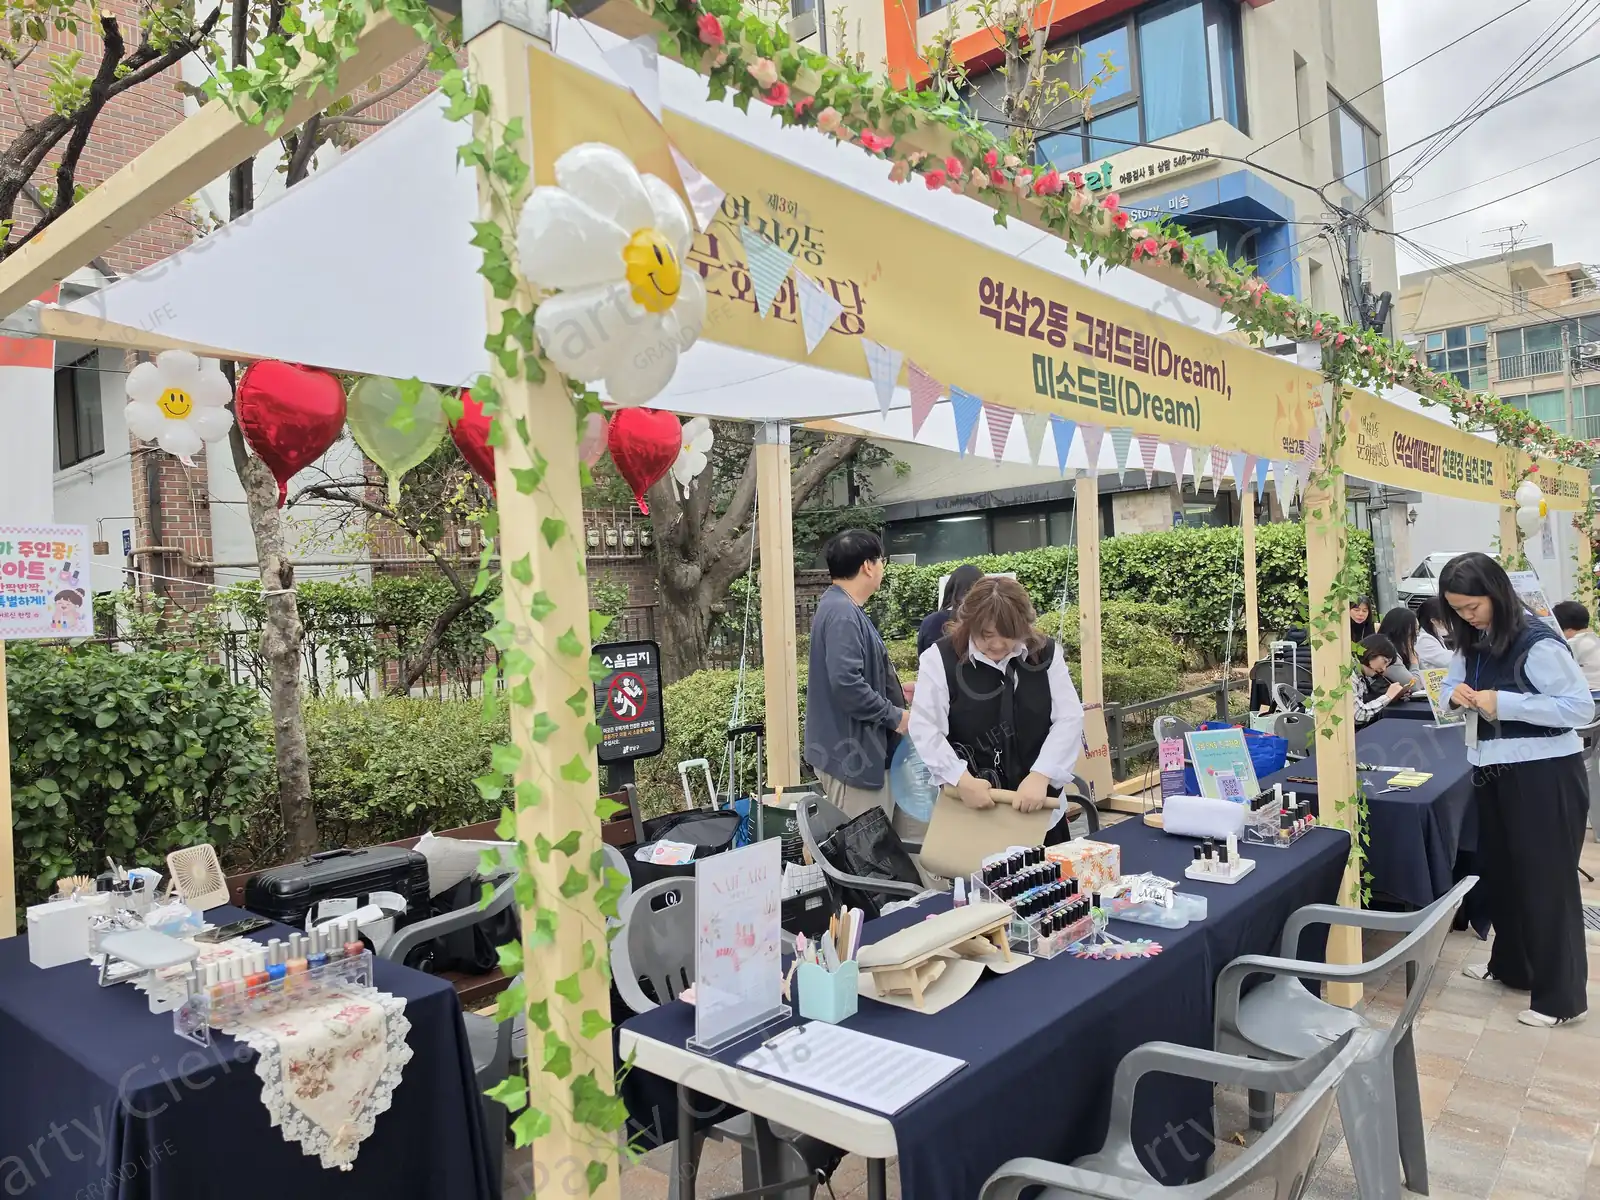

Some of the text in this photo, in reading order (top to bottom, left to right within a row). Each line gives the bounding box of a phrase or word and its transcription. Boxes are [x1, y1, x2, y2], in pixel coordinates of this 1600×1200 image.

[1119, 168, 1146, 185] 아동검사
[1148, 163, 1155, 176] 및
[1157, 158, 1171, 174] 상담
[767, 192, 799, 218] 제3회
[1168, 193, 1190, 210] 미술
[978, 276, 1233, 402] 역삼2동 그려드림(Dream),
[1031, 352, 1202, 432] 미소드림(Dream)
[1442, 447, 1465, 482] 친환경
[1465, 455, 1480, 485] 실천
[1480, 458, 1494, 486] 퀴즈
[17, 541, 73, 561] 주인공!
[0, 560, 46, 581] 아트
[601, 651, 650, 669] 소음금지
